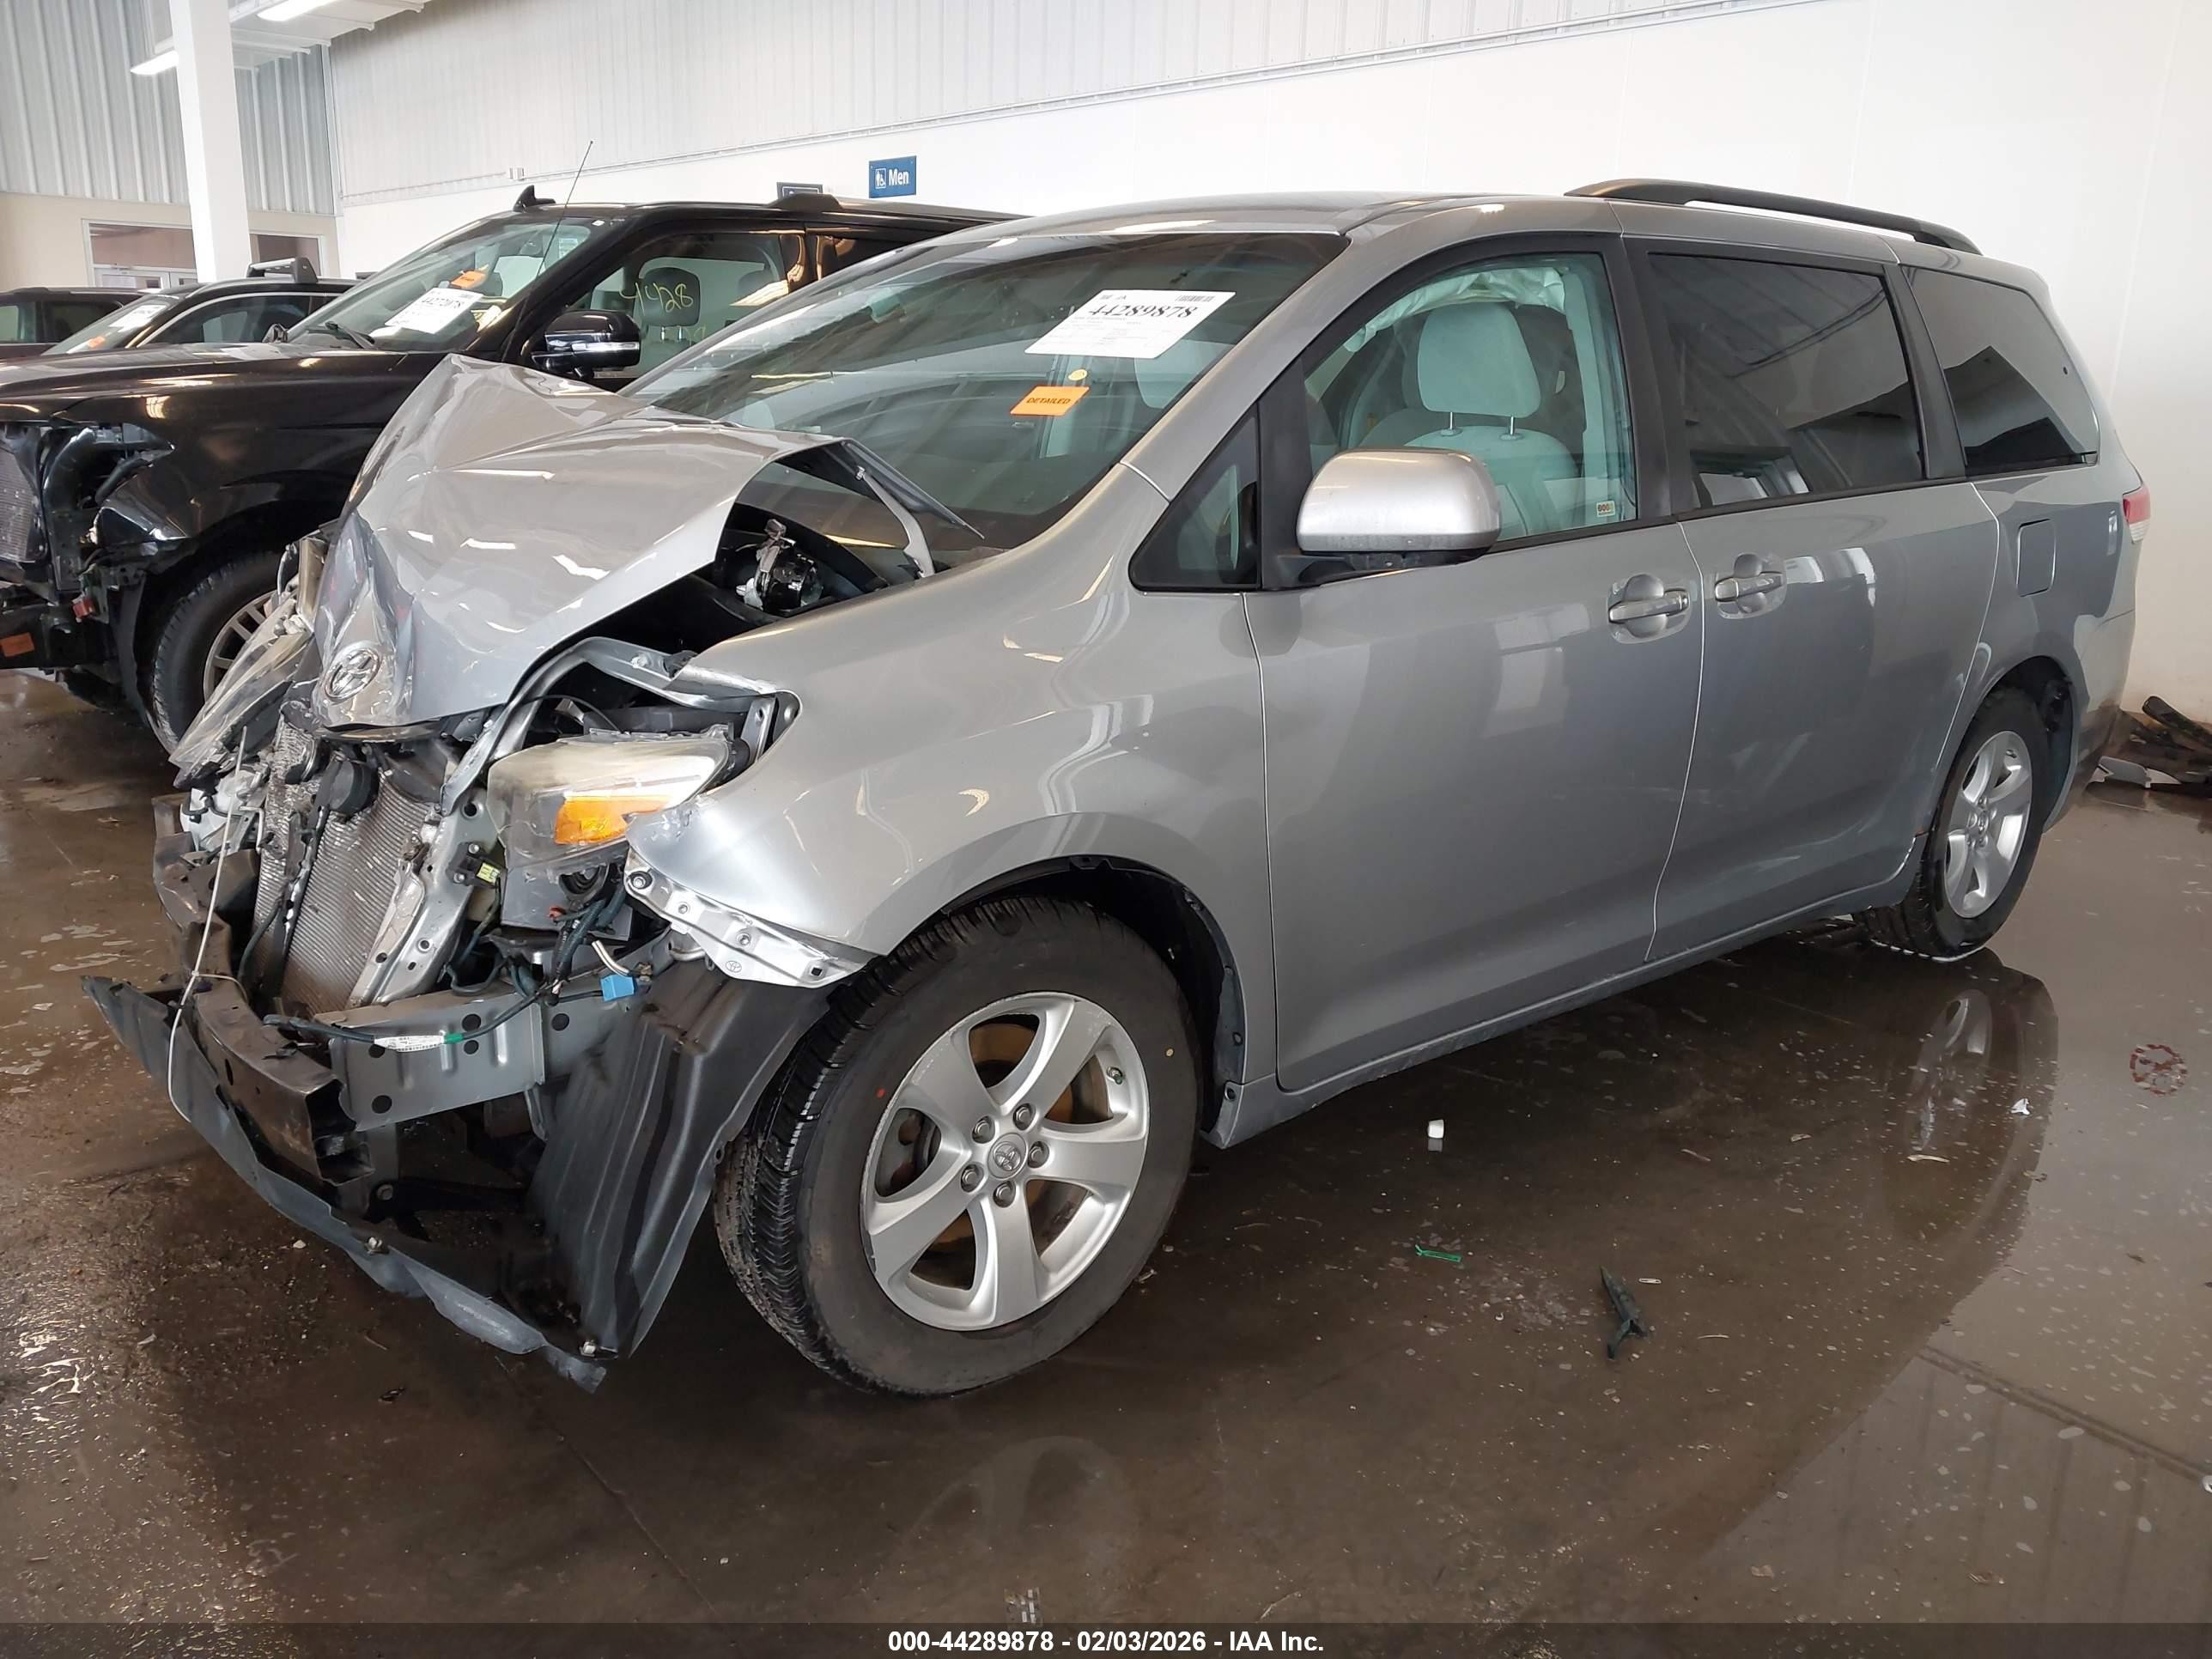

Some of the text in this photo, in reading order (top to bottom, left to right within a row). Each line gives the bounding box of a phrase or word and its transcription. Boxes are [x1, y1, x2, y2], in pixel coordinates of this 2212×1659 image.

[888, 168, 909, 186] Men
[618, 282, 694, 316] 4428
[1088, 303, 1199, 319] 44289878
